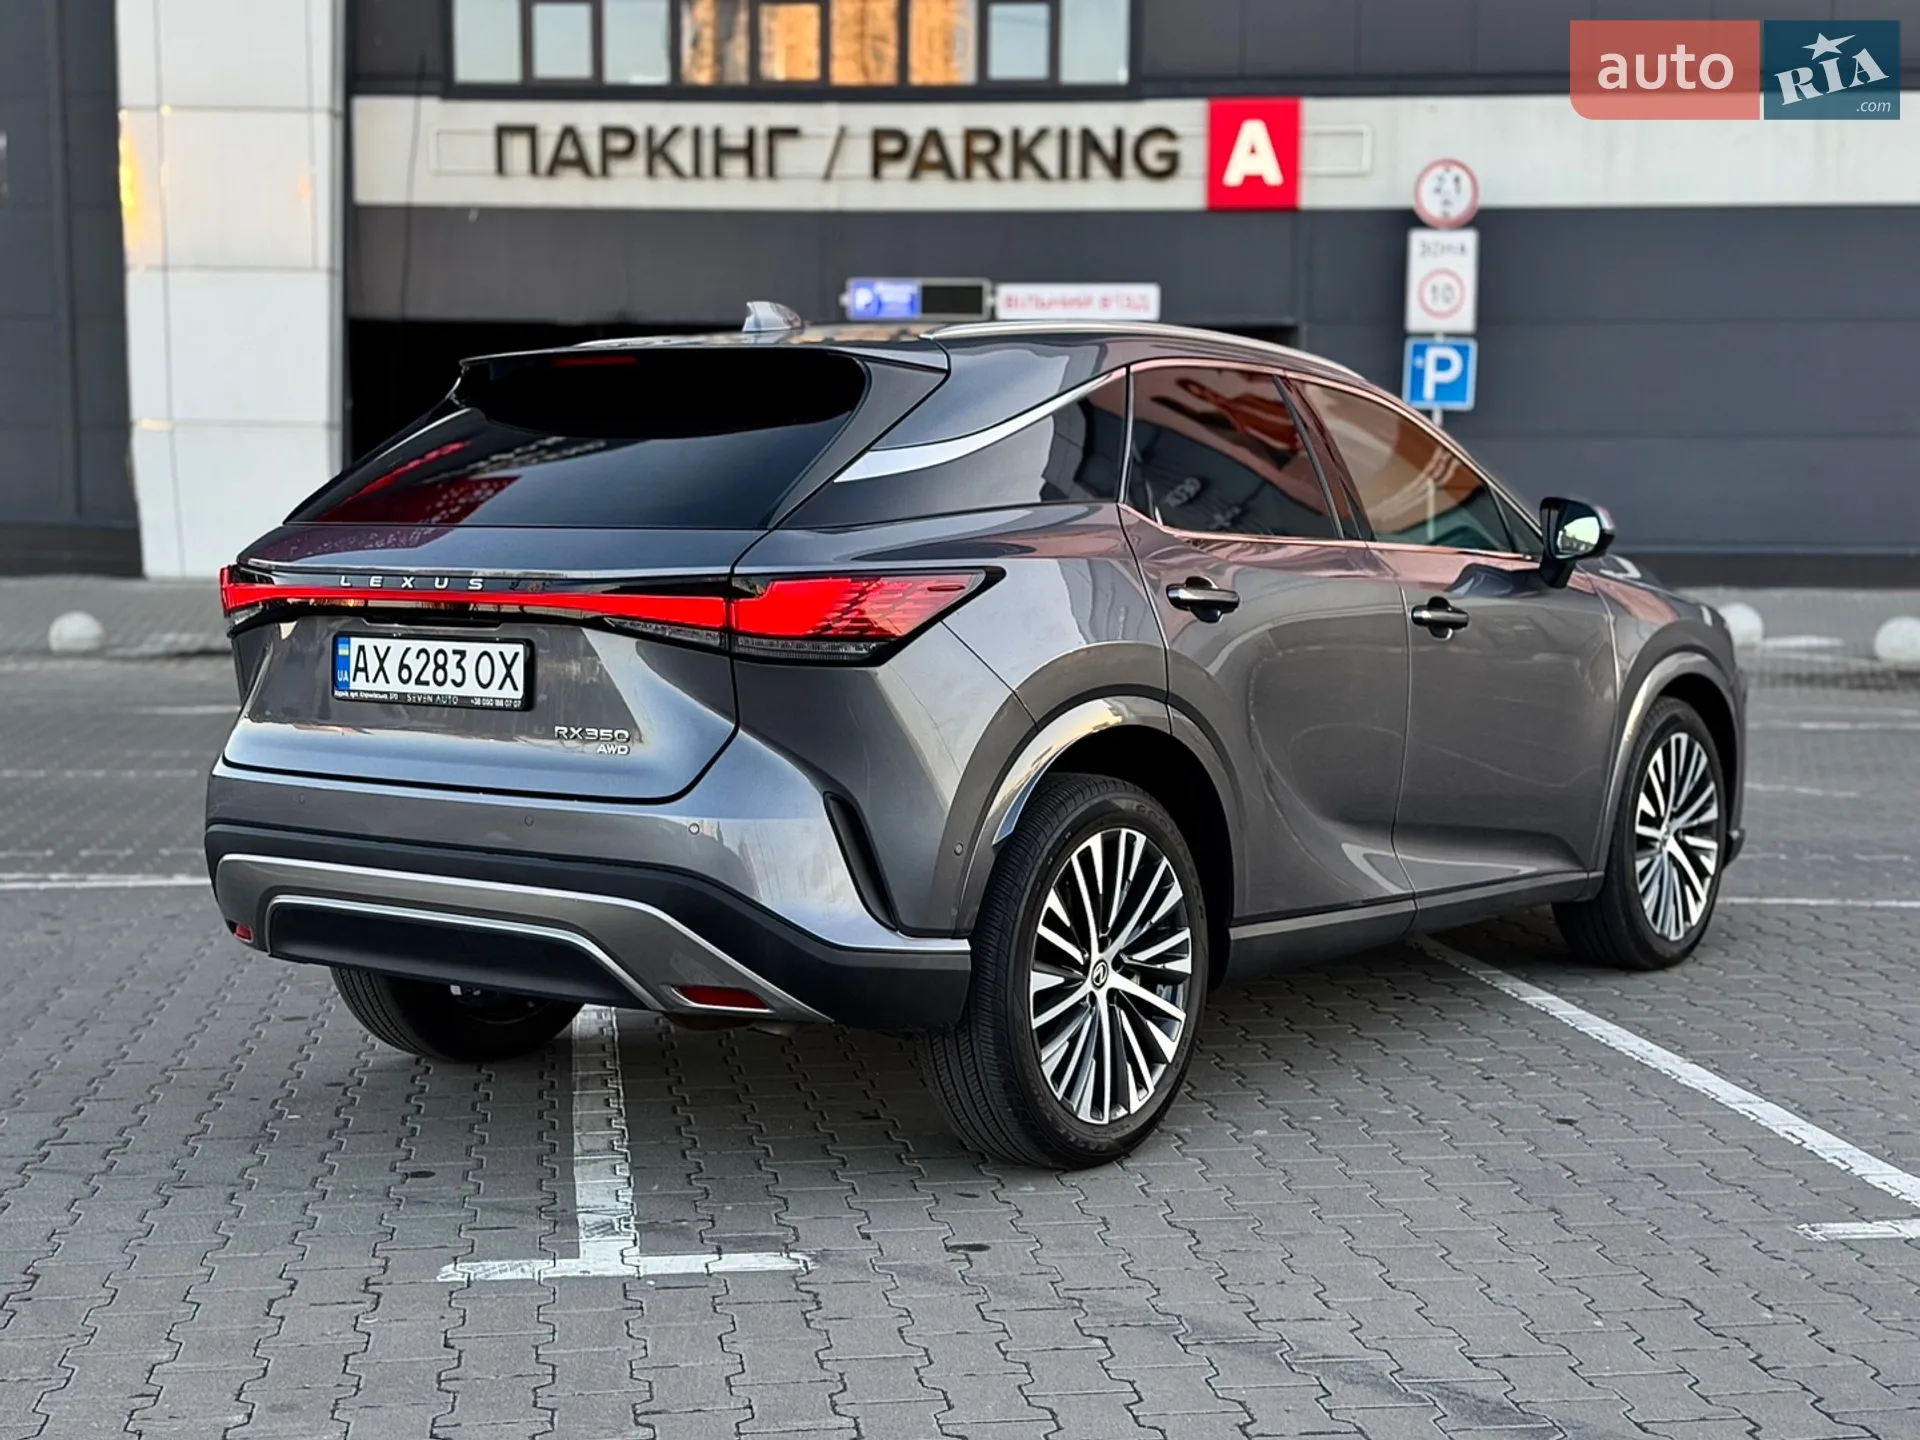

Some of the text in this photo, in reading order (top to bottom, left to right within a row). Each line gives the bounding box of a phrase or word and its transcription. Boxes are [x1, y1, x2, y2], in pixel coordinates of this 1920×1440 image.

[495, 123, 801, 179] ПАРКІНГ
[870, 125, 1182, 183] PARKING
[1221, 118, 1285, 187] A
[1430, 283, 1456, 305] 10
[1422, 345, 1464, 401] P
[339, 575, 484, 590] LEXUS
[337, 669, 349, 682] UA
[352, 644, 520, 692] AX 6283 OX
[436, 694, 459, 705] AUTO
[596, 744, 631, 756] AWD
